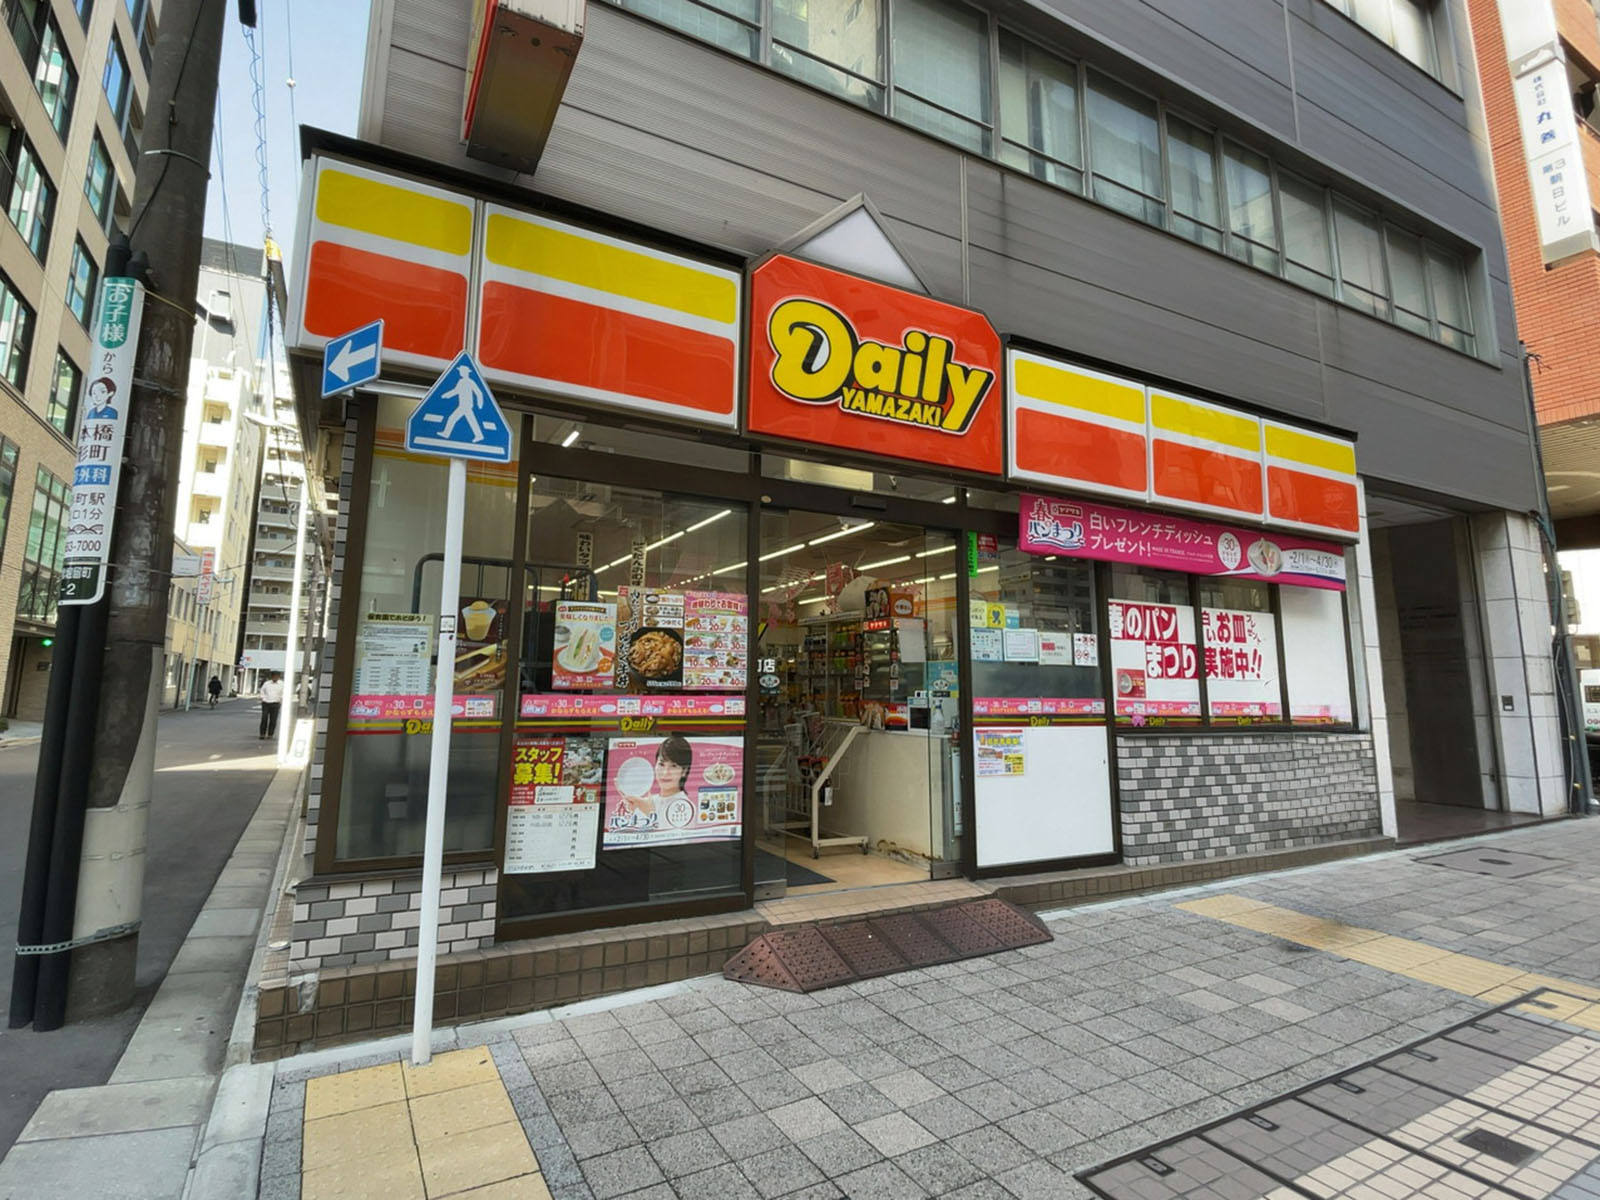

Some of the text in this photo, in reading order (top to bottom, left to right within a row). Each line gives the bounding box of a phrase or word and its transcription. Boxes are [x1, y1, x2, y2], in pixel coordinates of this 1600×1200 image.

[102, 286, 131, 342] お子様
[102, 352, 117, 375] から
[768, 298, 995, 434] Daily
[842, 387, 942, 427] YAMAZAKI
[1090, 512, 1213, 546] 白いフレンチディッシュ
[1090, 534, 1151, 557] プレゼント!
[1109, 604, 1177, 640] 春のパン
[1147, 643, 1197, 679] まつり
[1204, 647, 1263, 679] 実施中!!
[620, 717, 654, 732] Daily
[515, 747, 562, 762] スタッフ
[513, 762, 561, 785] 募集!
